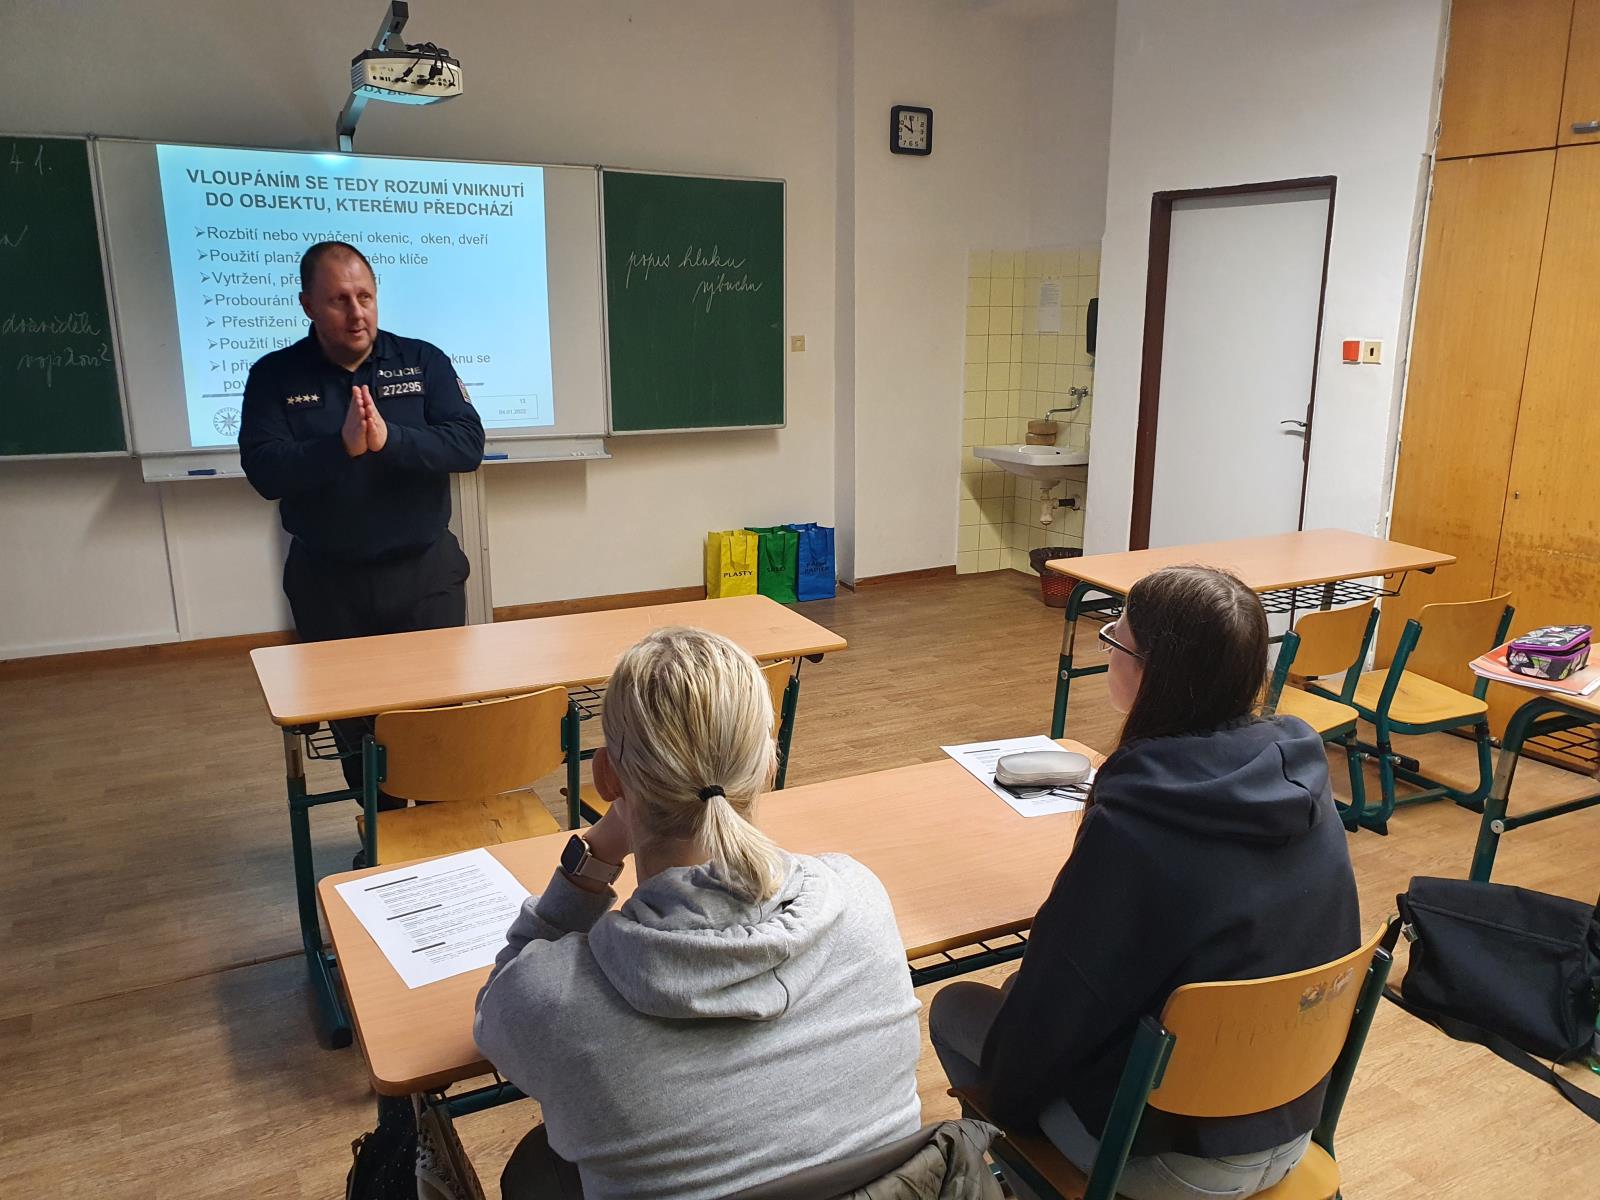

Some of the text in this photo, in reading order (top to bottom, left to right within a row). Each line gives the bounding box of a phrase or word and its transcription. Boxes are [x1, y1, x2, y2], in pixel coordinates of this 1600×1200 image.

[186, 168, 524, 198] VLOUPÁNÍM SE TEDY ROZUMÍ VNIKNUTÍ
[206, 192, 513, 216] DO OBJEKTU, KTERÉMU PŘEDCHÁZÍ
[208, 226, 488, 246] Rozbití nebo vypáčení okenic, oken, dveří
[210, 249, 259, 262] Použití
[264, 251, 301, 265] planž
[400, 253, 428, 264] klíče
[212, 272, 302, 287] Vytržení, pře
[215, 294, 294, 306] Probourání
[222, 316, 297, 328] Přestřižení
[220, 338, 268, 350] Použití
[452, 354, 473, 364] knu
[476, 354, 490, 363] se
[377, 366, 422, 378] POLICIE
[383, 382, 422, 396] 272295
[724, 570, 753, 578] PLASTY
